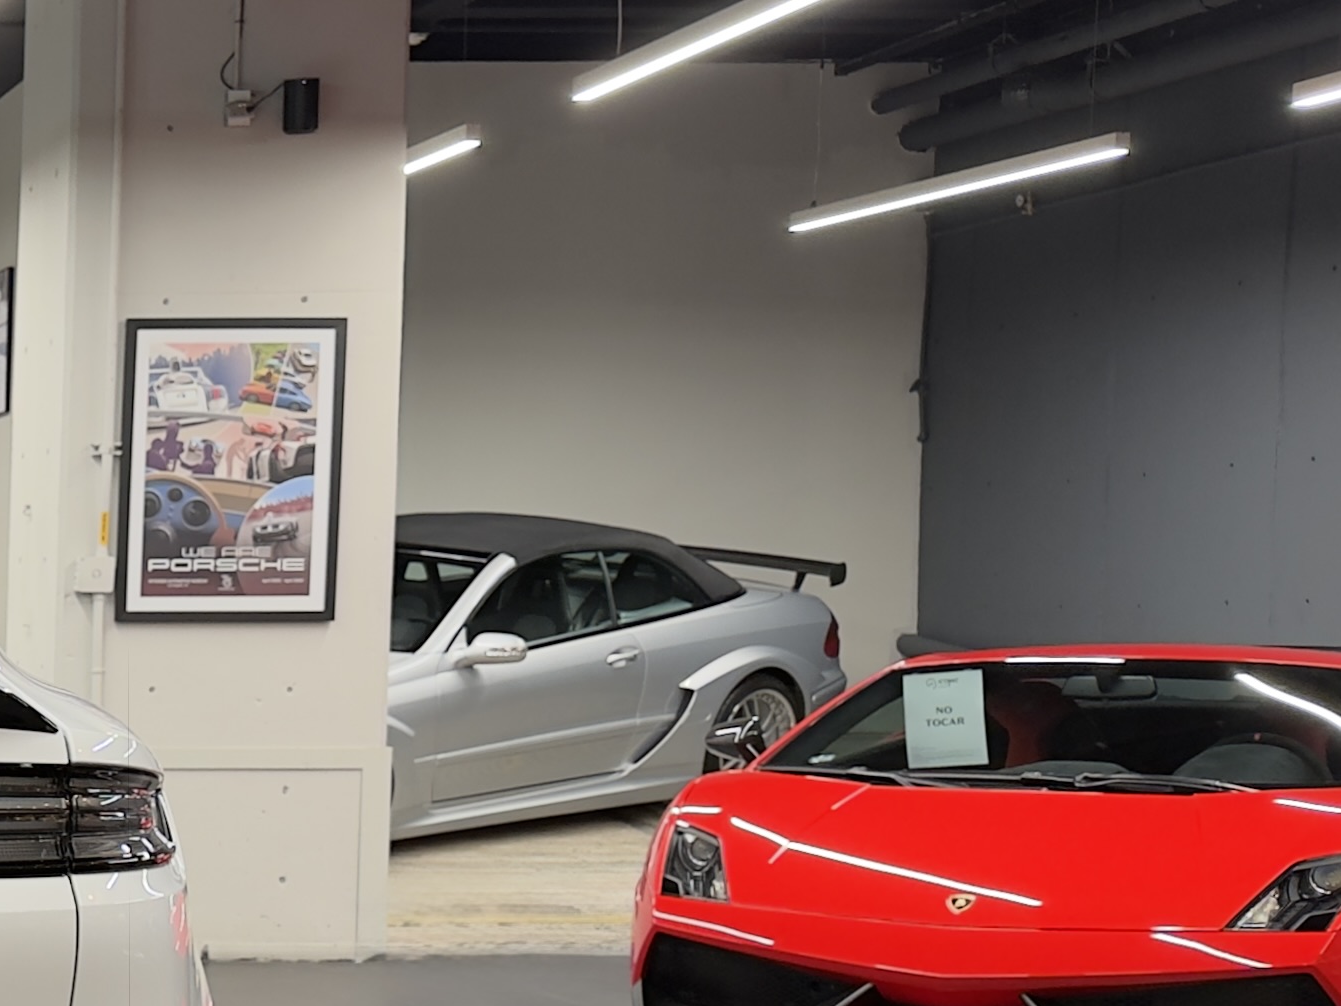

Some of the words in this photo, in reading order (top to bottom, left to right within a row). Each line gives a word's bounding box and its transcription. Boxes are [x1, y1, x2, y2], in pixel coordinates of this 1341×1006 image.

[181, 546, 216, 558] WE
[221, 546, 272, 558] ARE
[147, 557, 305, 572] PORSCHE
[936, 706, 953, 715] NO
[926, 717, 965, 728] TOCAR
